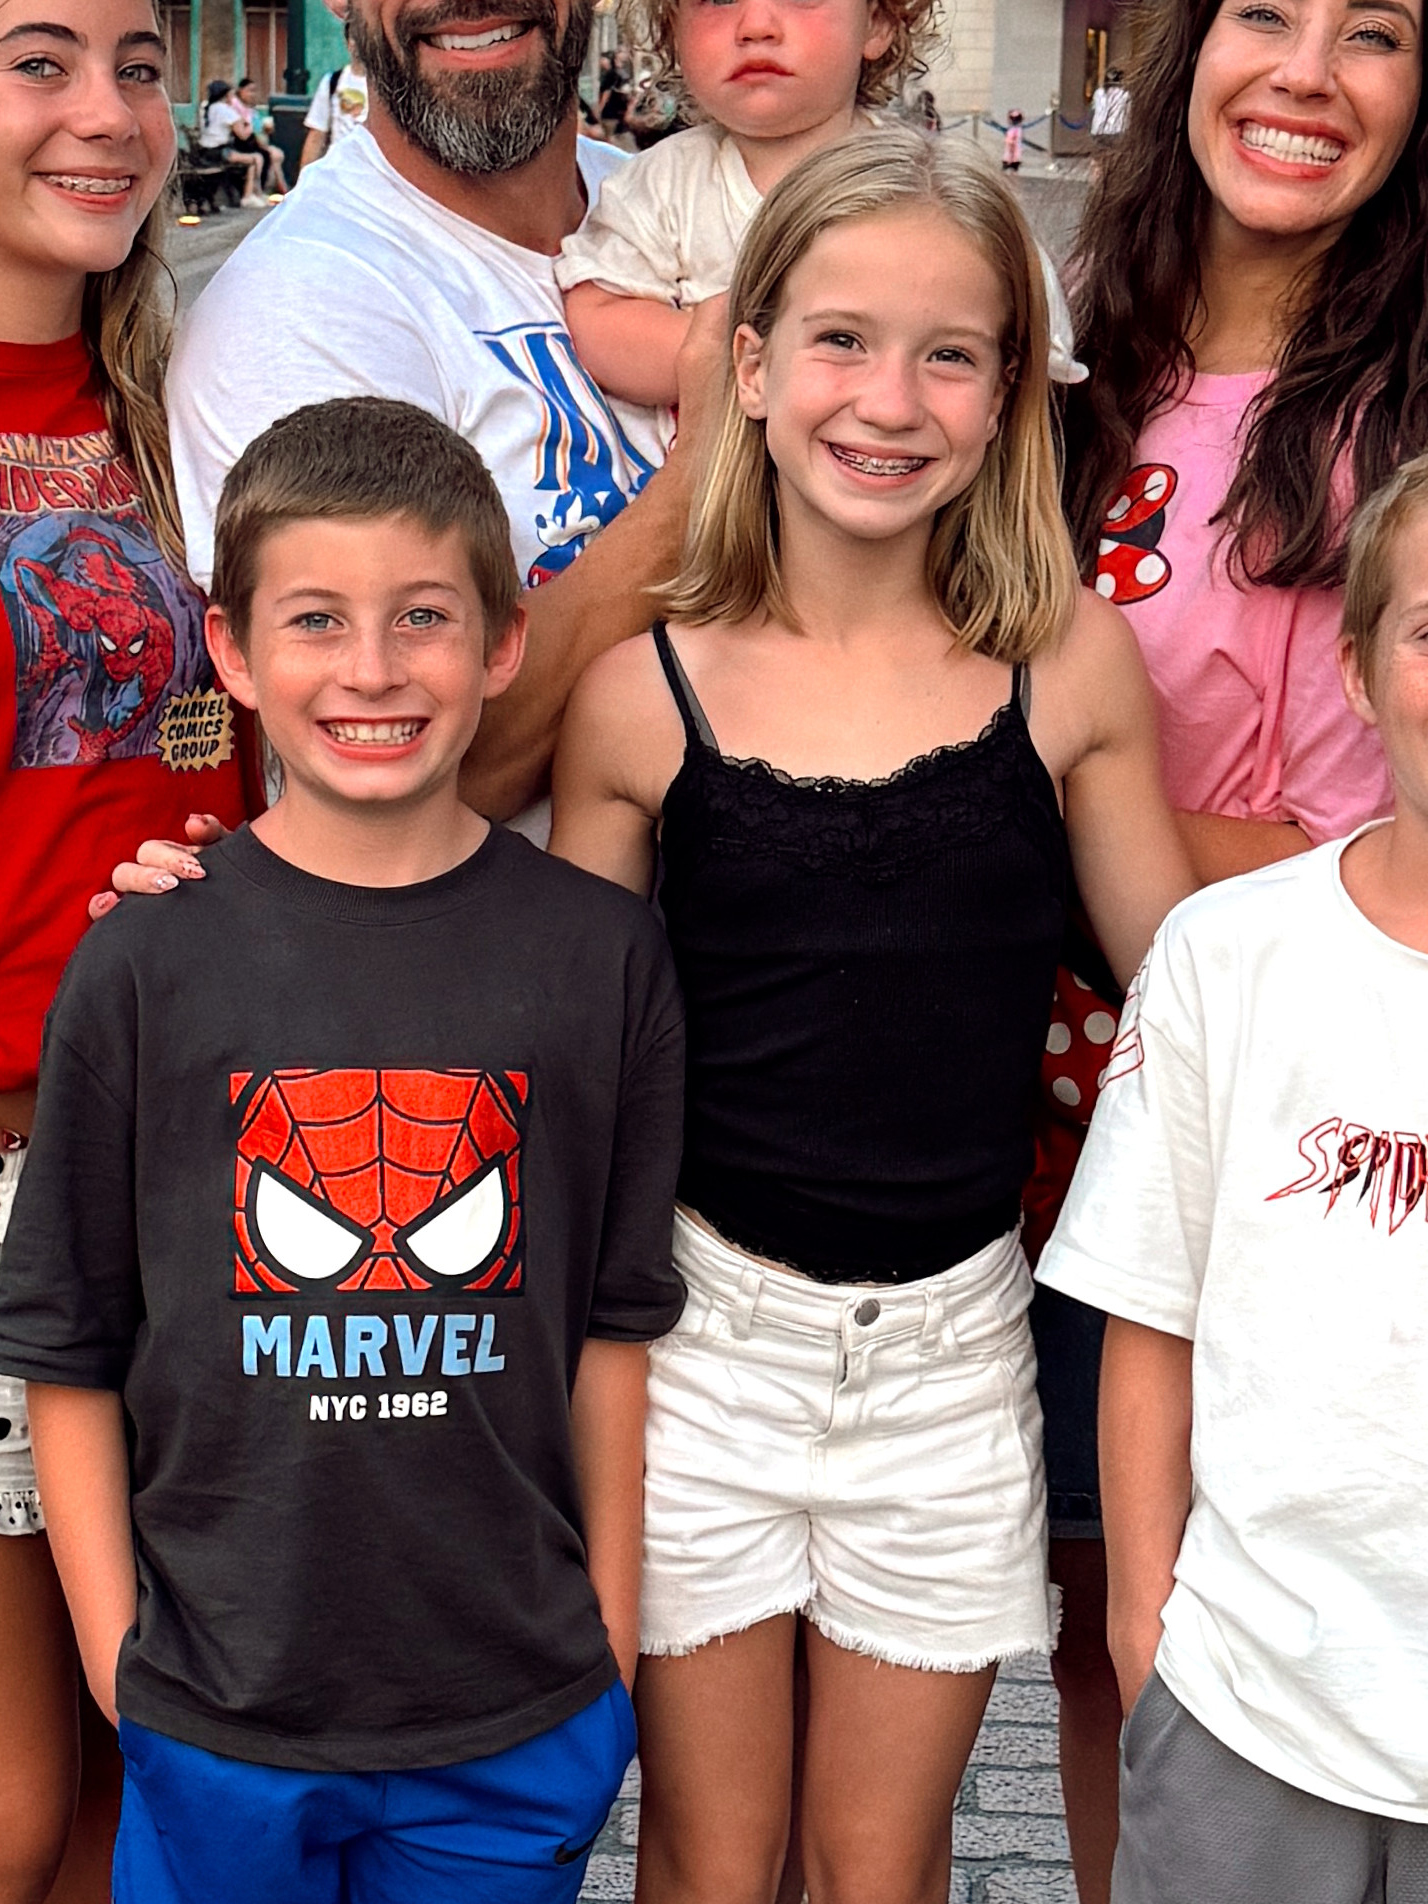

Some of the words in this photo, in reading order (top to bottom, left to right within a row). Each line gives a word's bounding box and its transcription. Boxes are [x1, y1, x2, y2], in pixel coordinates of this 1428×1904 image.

[168, 698, 225, 721] MARVEL
[167, 718, 224, 741] COMICS
[171, 739, 220, 761] GROUP
[241, 1312, 506, 1379] MARVEL
[309, 1394, 368, 1421] NYC
[377, 1390, 449, 1420] 1962
